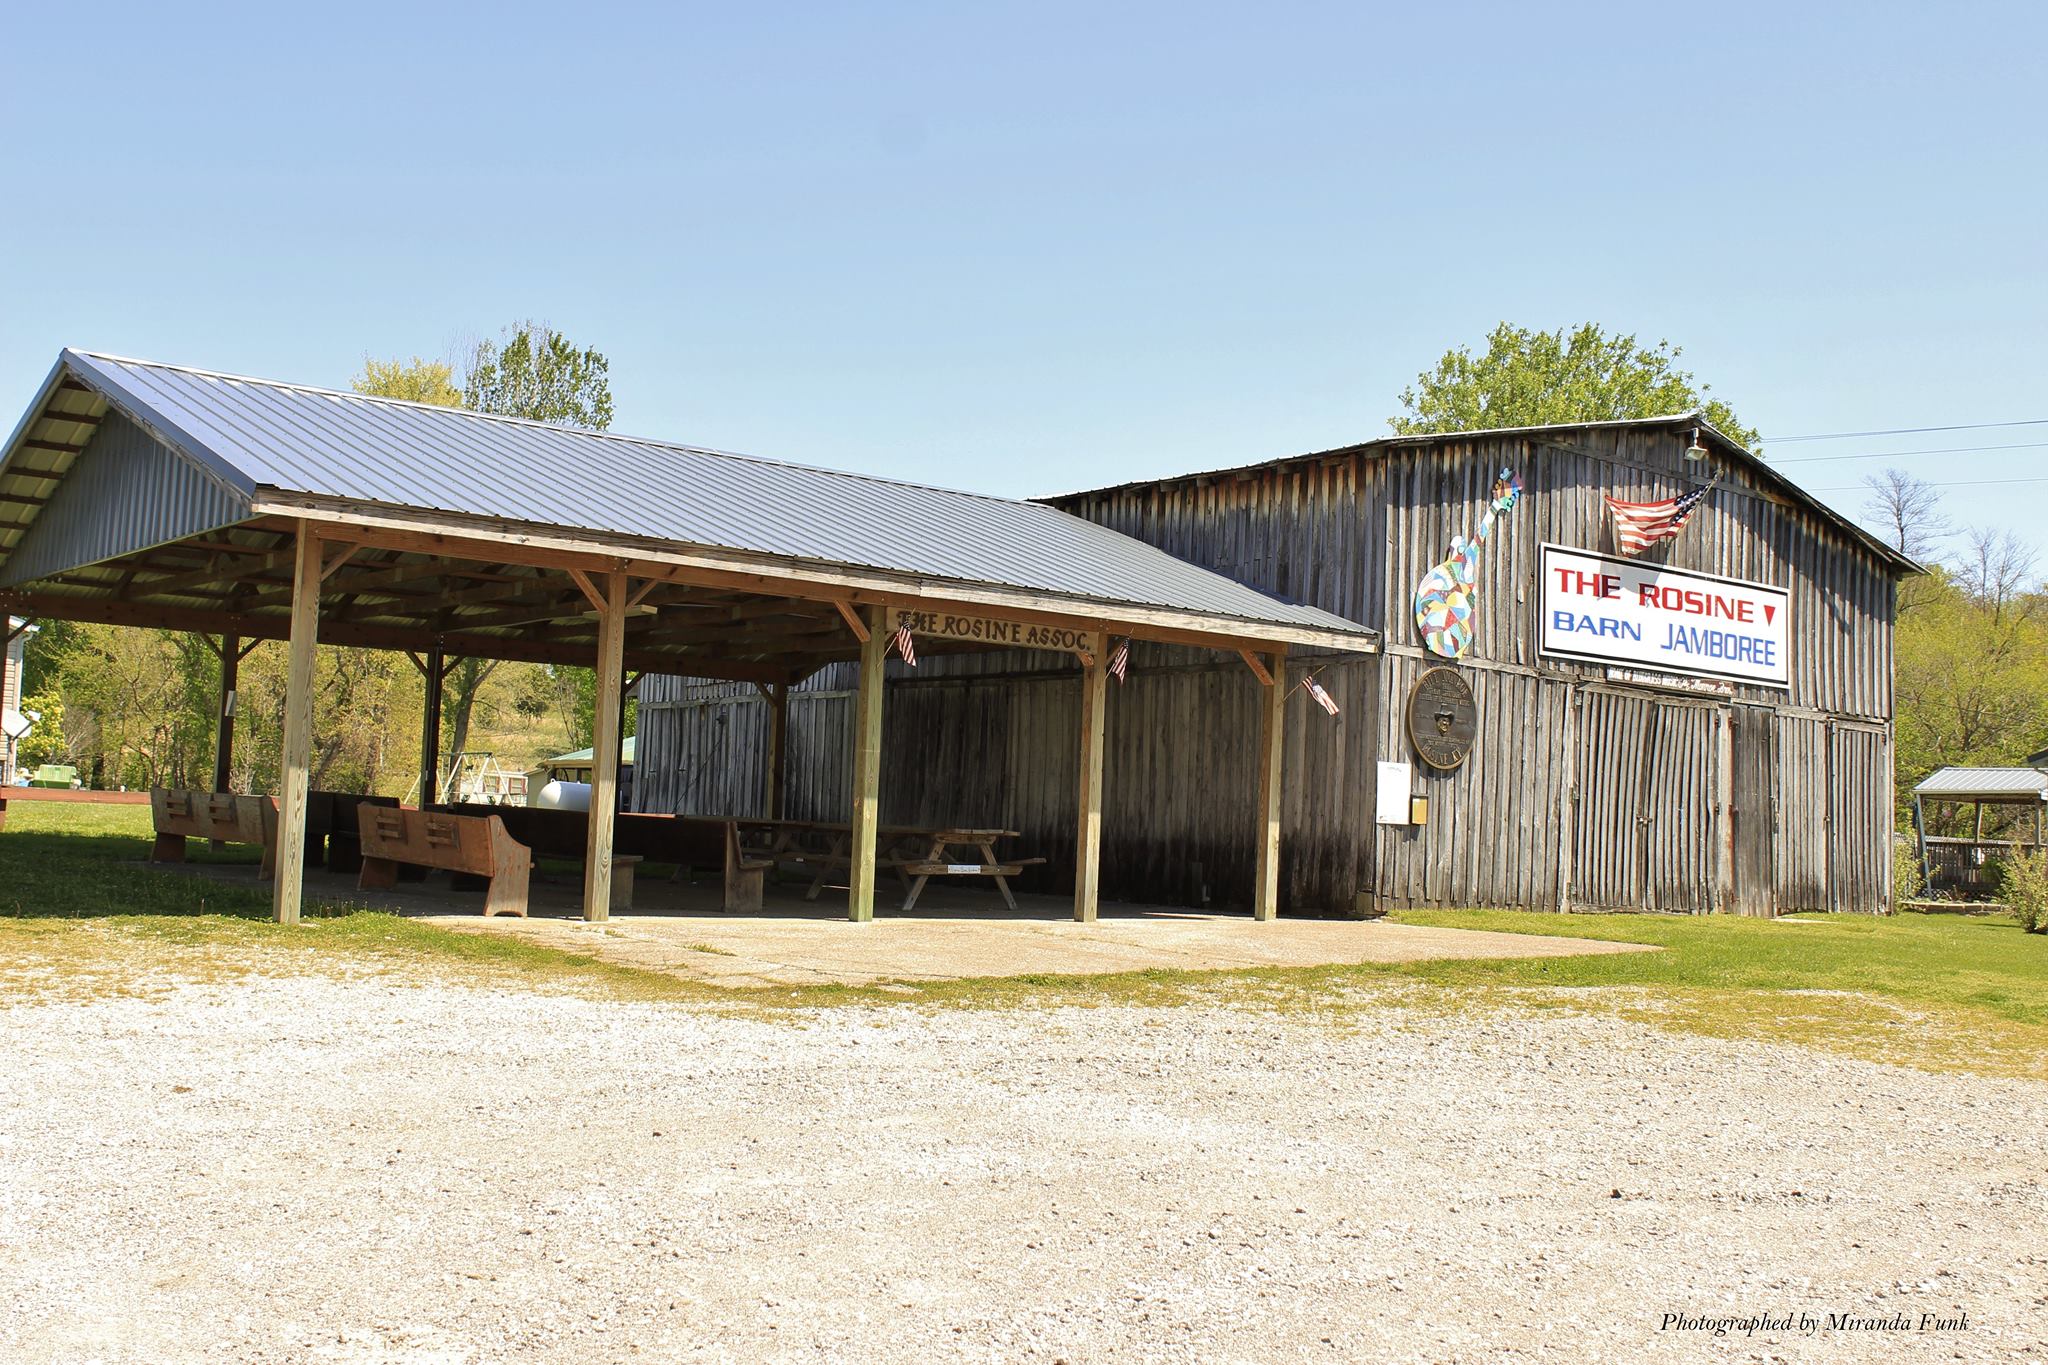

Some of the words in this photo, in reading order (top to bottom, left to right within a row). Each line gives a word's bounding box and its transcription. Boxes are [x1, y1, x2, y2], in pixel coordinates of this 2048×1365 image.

[1554, 567, 1621, 600] THE
[1639, 582, 1754, 623] ROSINE
[896, 610, 938, 633] THE
[942, 616, 1021, 643] ROSINE
[1026, 626, 1091, 651] ASSOC.
[1553, 610, 1641, 642] BARN
[1660, 623, 1776, 667] JAMBOREE
